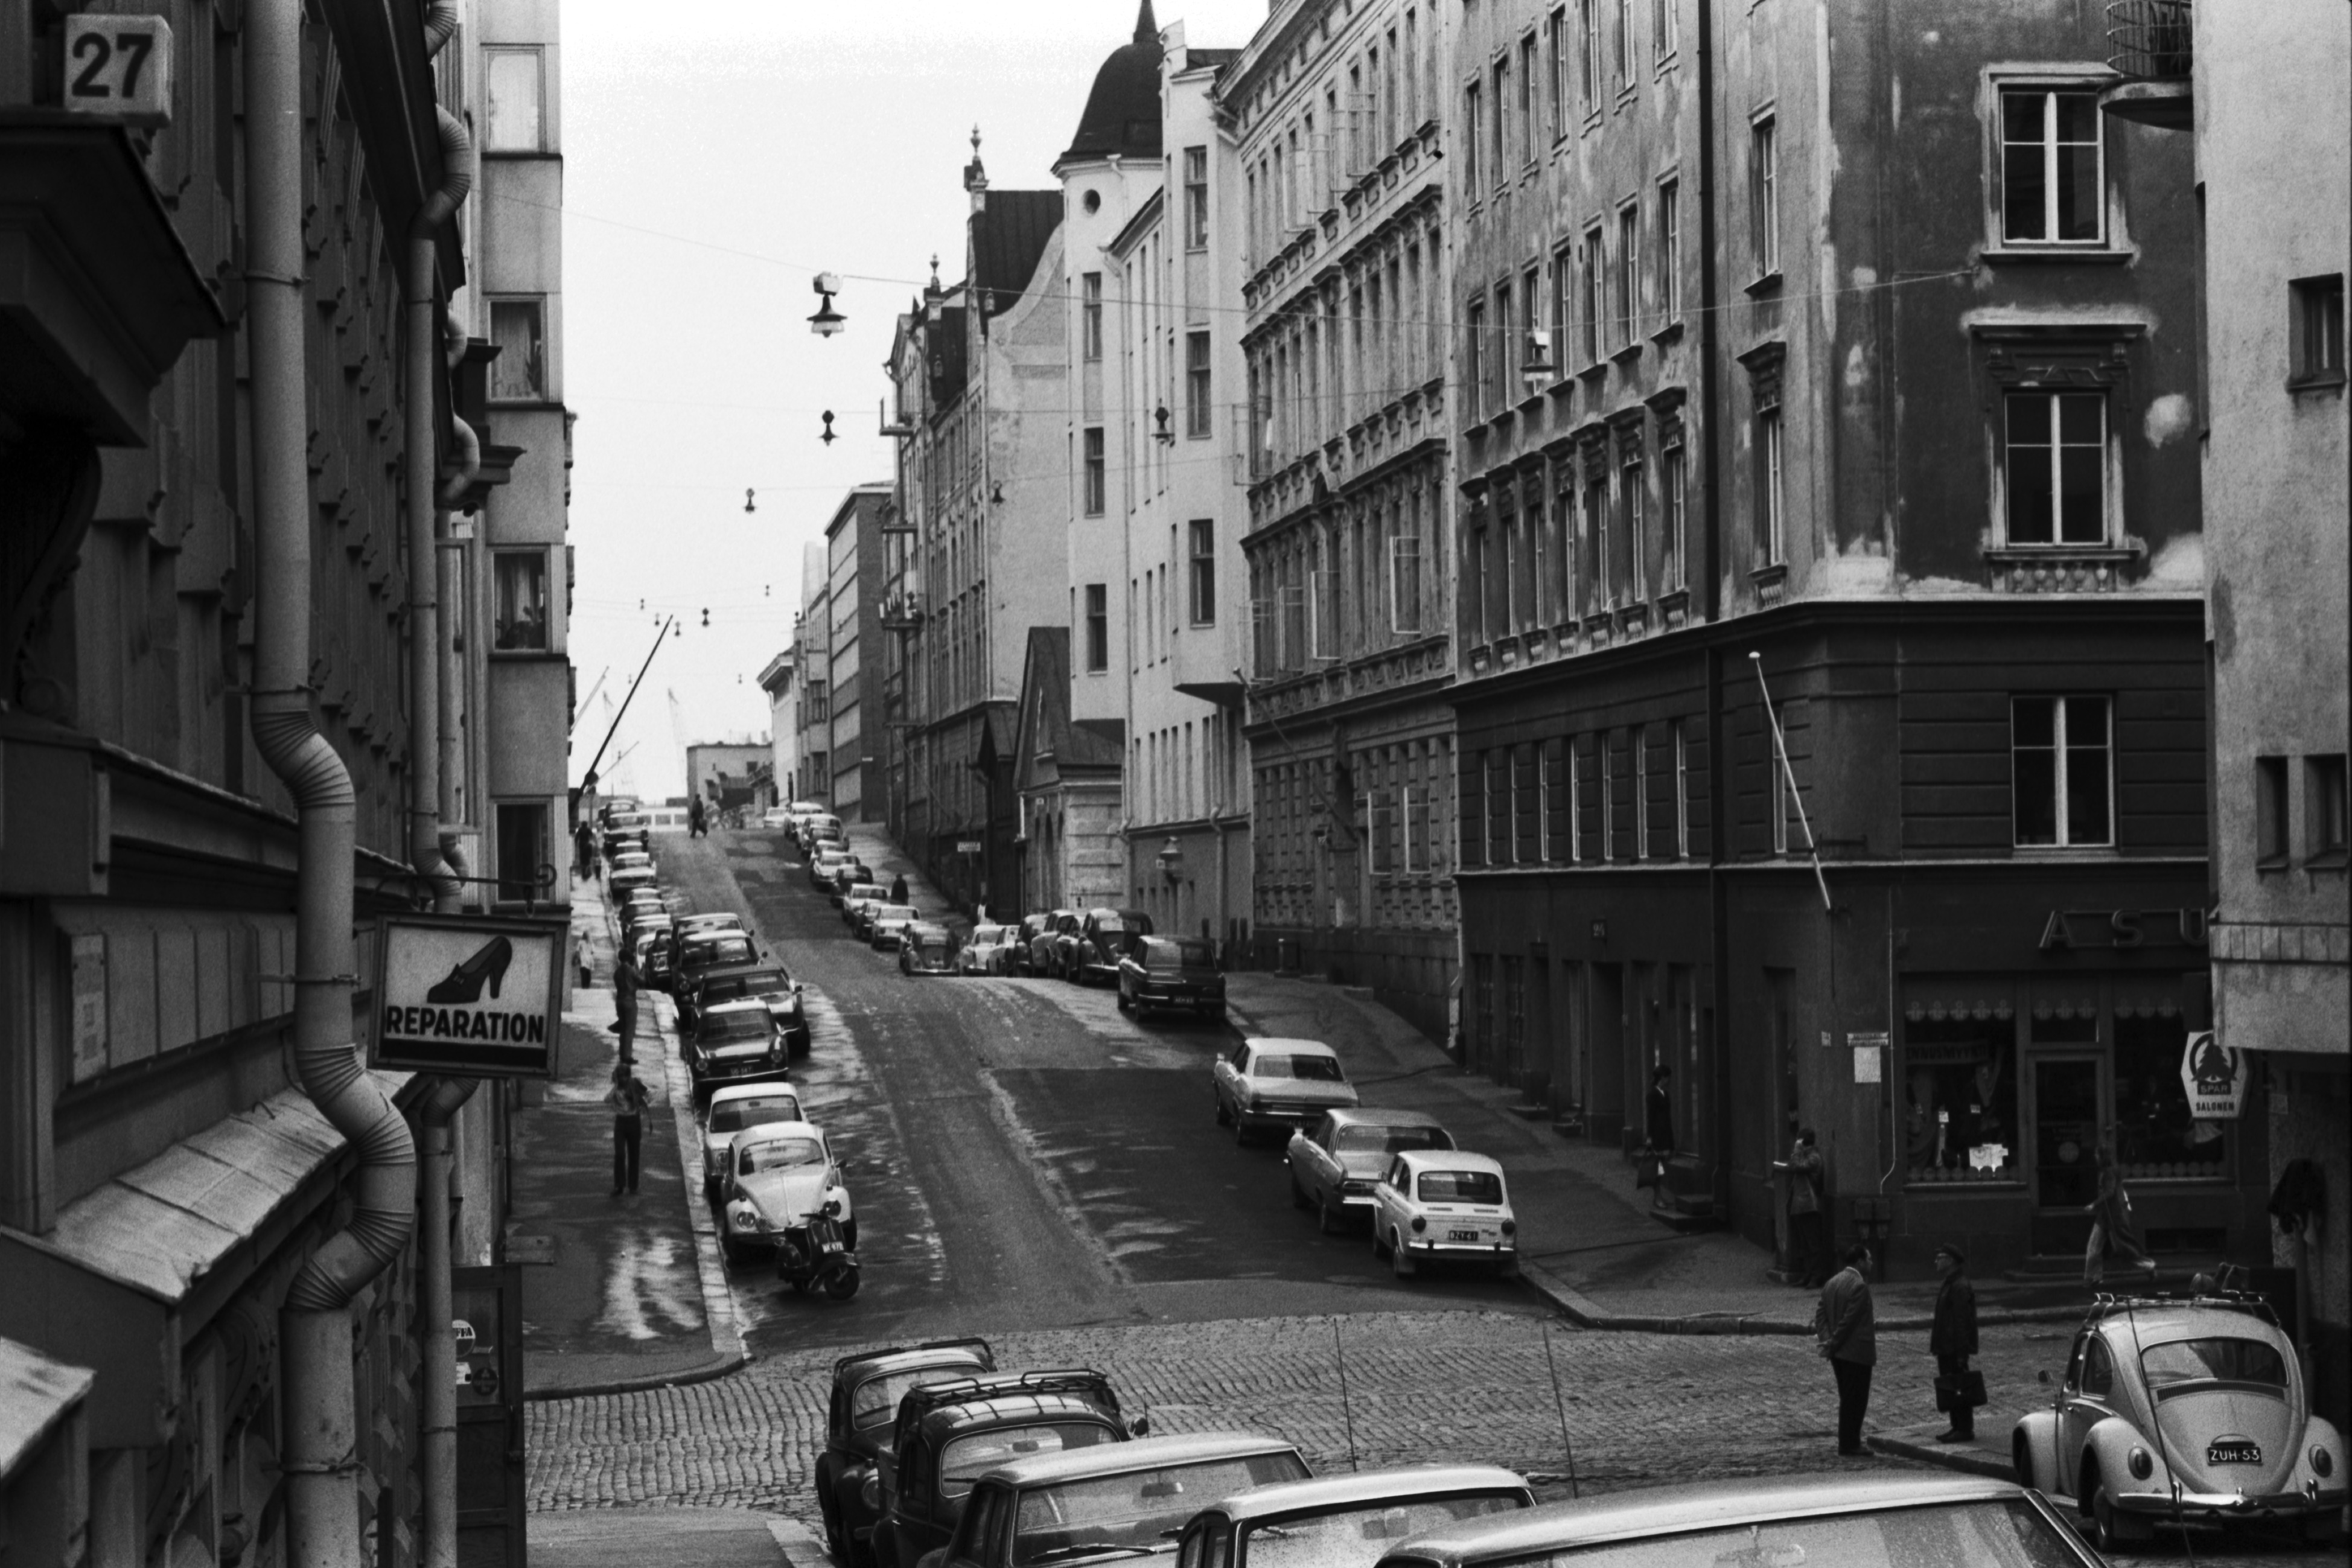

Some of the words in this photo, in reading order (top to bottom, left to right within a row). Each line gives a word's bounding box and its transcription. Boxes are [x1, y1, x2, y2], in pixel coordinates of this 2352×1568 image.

[72, 32, 153, 98] 27
[386, 1005, 544, 1043] REPARATION
[2200, 1085, 2228, 1093] SPAR
[2196, 1101, 2235, 1112] SALONEN
